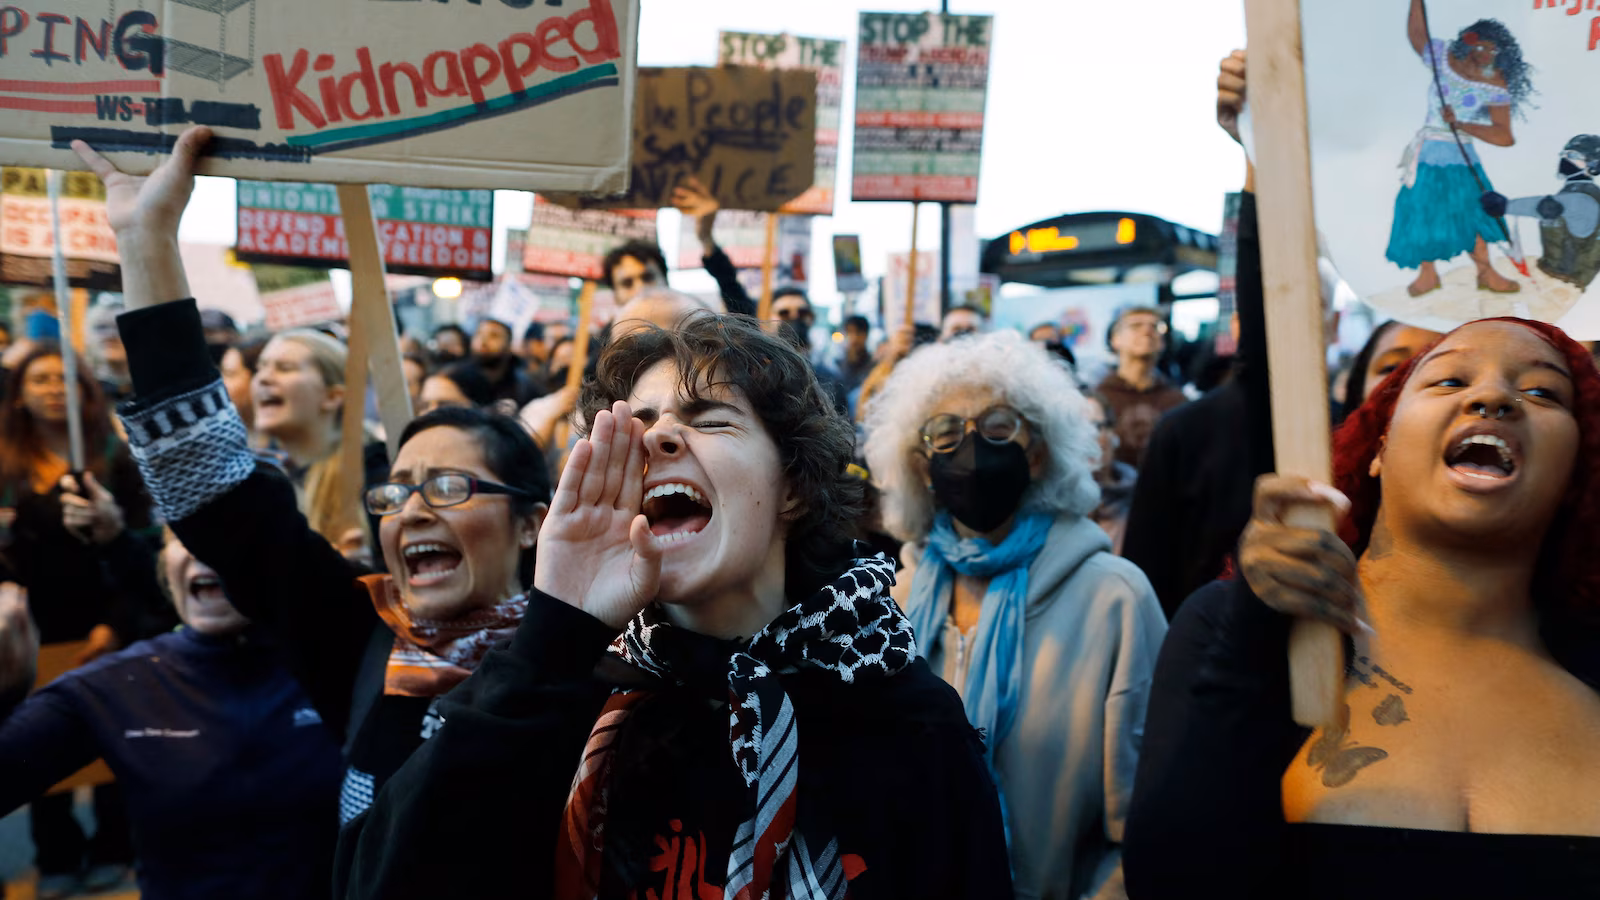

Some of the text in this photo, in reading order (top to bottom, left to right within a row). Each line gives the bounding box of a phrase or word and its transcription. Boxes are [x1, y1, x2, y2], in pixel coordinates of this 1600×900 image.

[862, 15, 986, 45] STOP THE
[262, 0, 622, 130] Kidnapped
[723, 34, 839, 66] STOP THE
[685, 70, 807, 136] People
[239, 208, 326, 238] DEFEND
[404, 200, 491, 227] STRIKE
